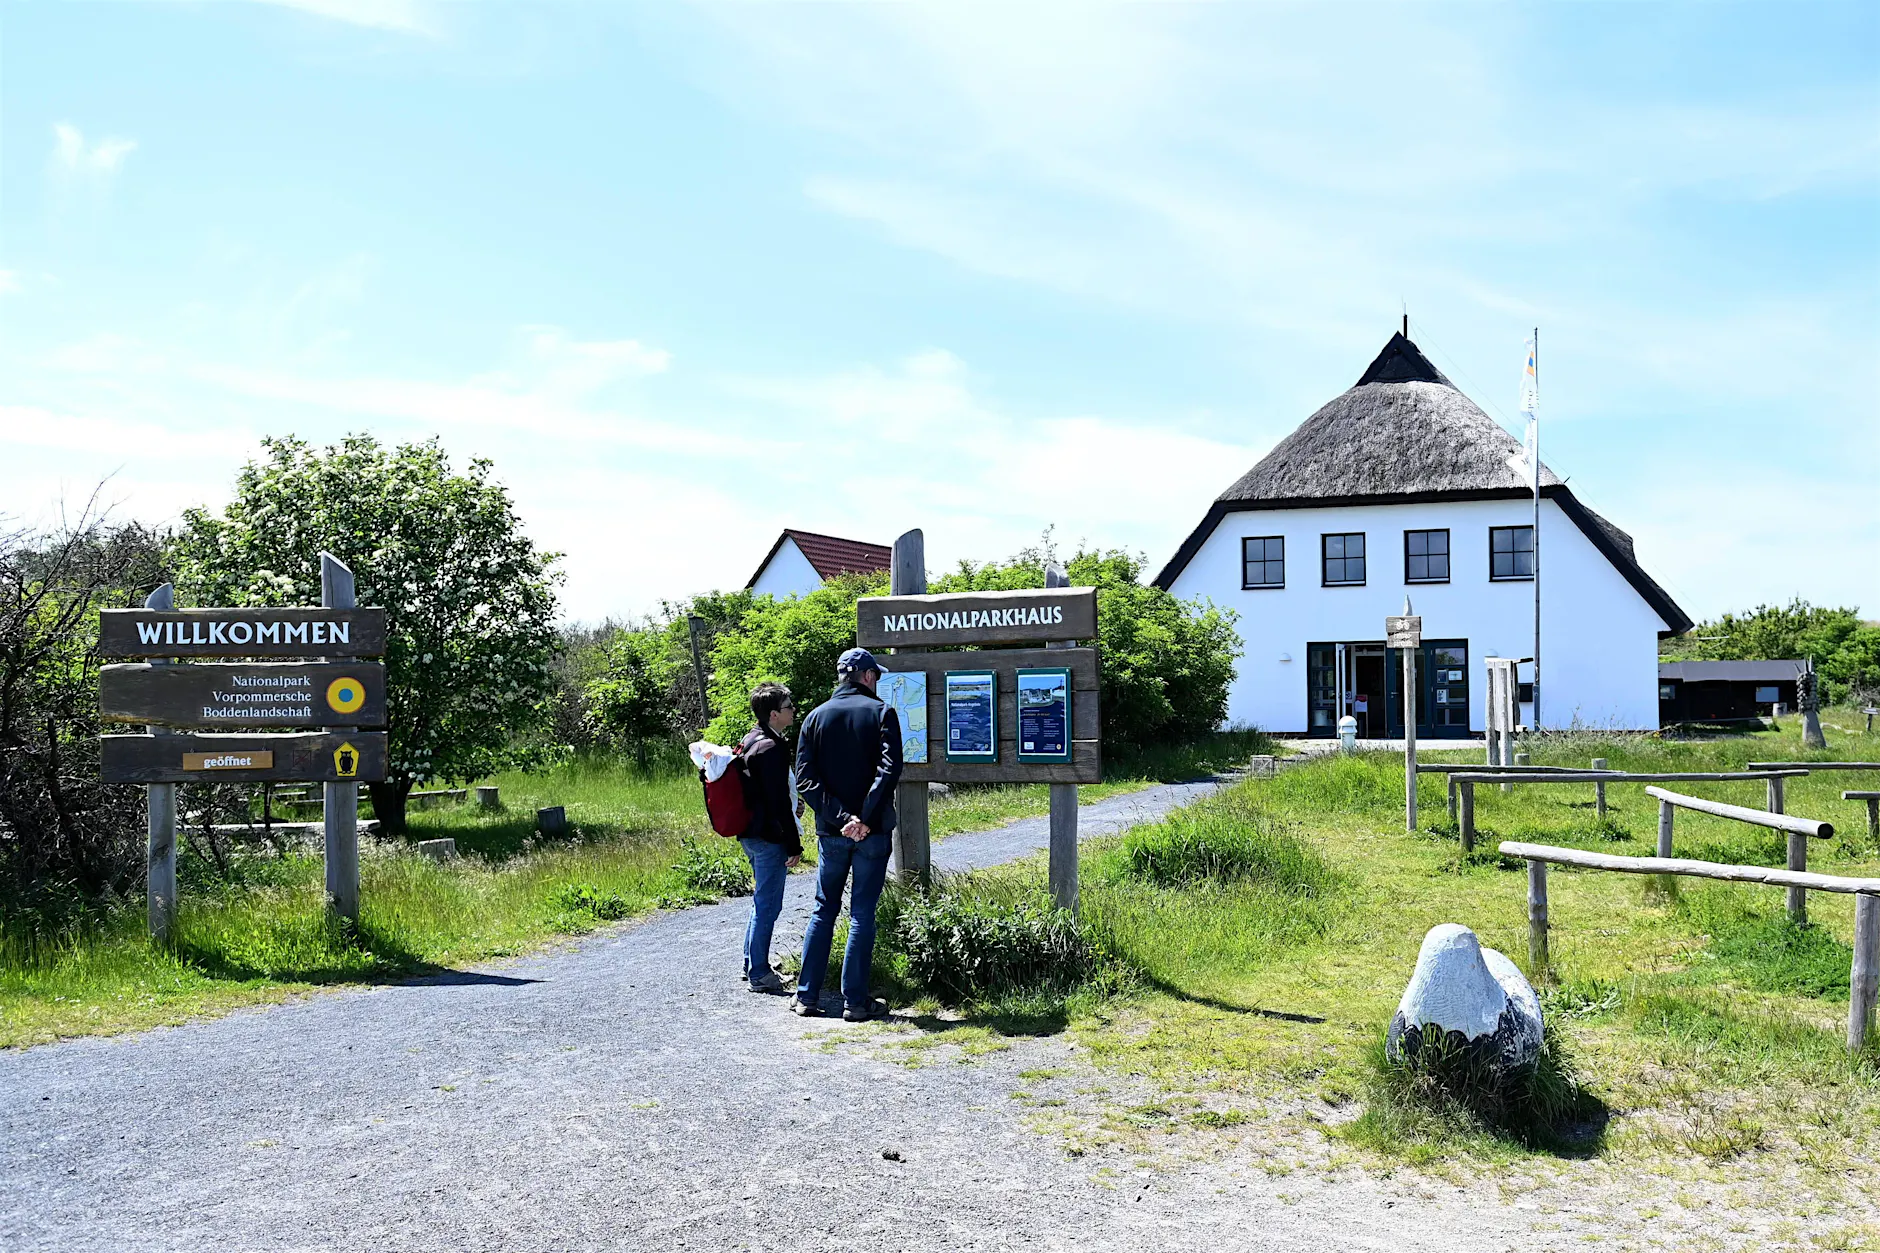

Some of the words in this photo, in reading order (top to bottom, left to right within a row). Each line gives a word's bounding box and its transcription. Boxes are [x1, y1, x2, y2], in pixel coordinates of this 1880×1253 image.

[883, 605, 1063, 632] NATIONALPARKHAUS
[136, 621, 350, 645] WILLKOMMEN
[232, 675, 311, 688] Nationalpark
[212, 691, 312, 704] Vorpommersche
[203, 706, 312, 719] Boddenlandschaft
[203, 755, 252, 769] geöffnet
